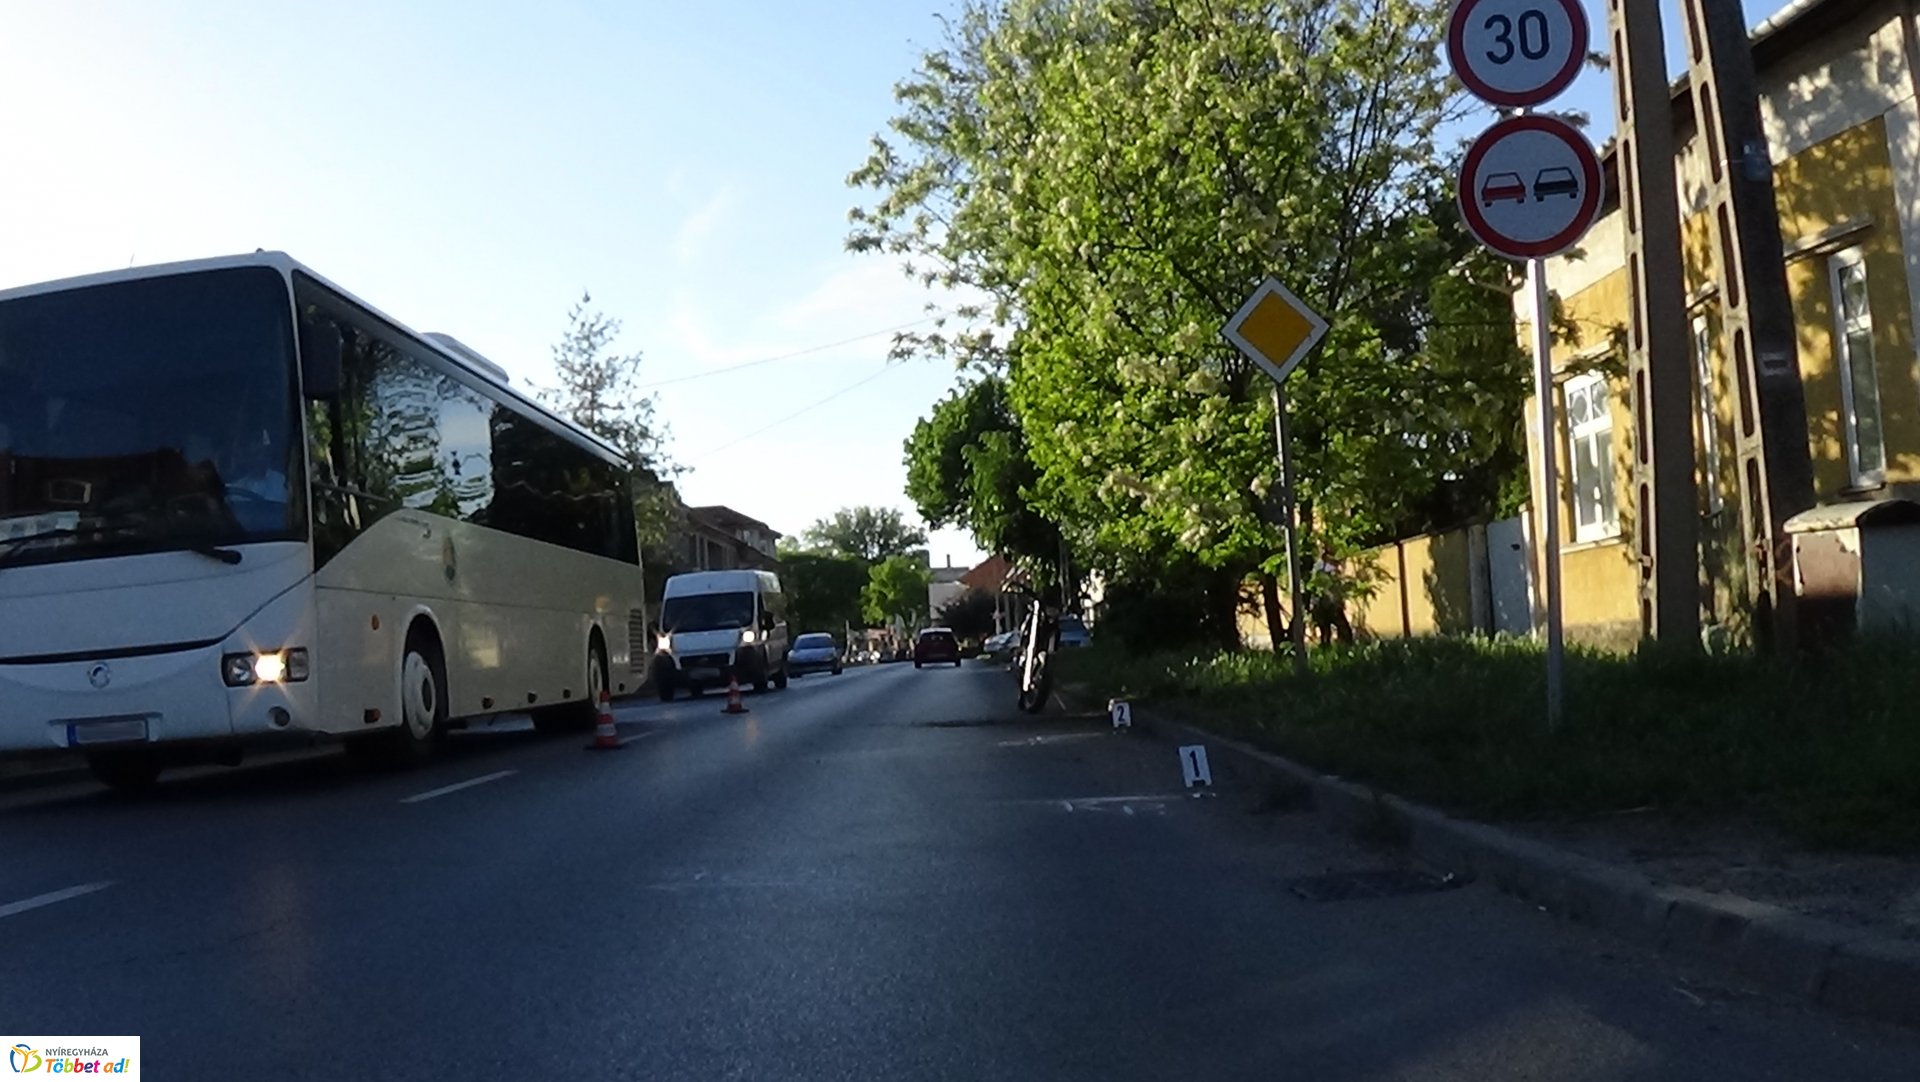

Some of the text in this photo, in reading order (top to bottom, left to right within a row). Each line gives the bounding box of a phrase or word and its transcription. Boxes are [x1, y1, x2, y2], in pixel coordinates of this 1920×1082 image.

[1484, 9, 1550, 65] 30
[1116, 704, 1126, 723] 2
[1189, 750, 1201, 778] 1
